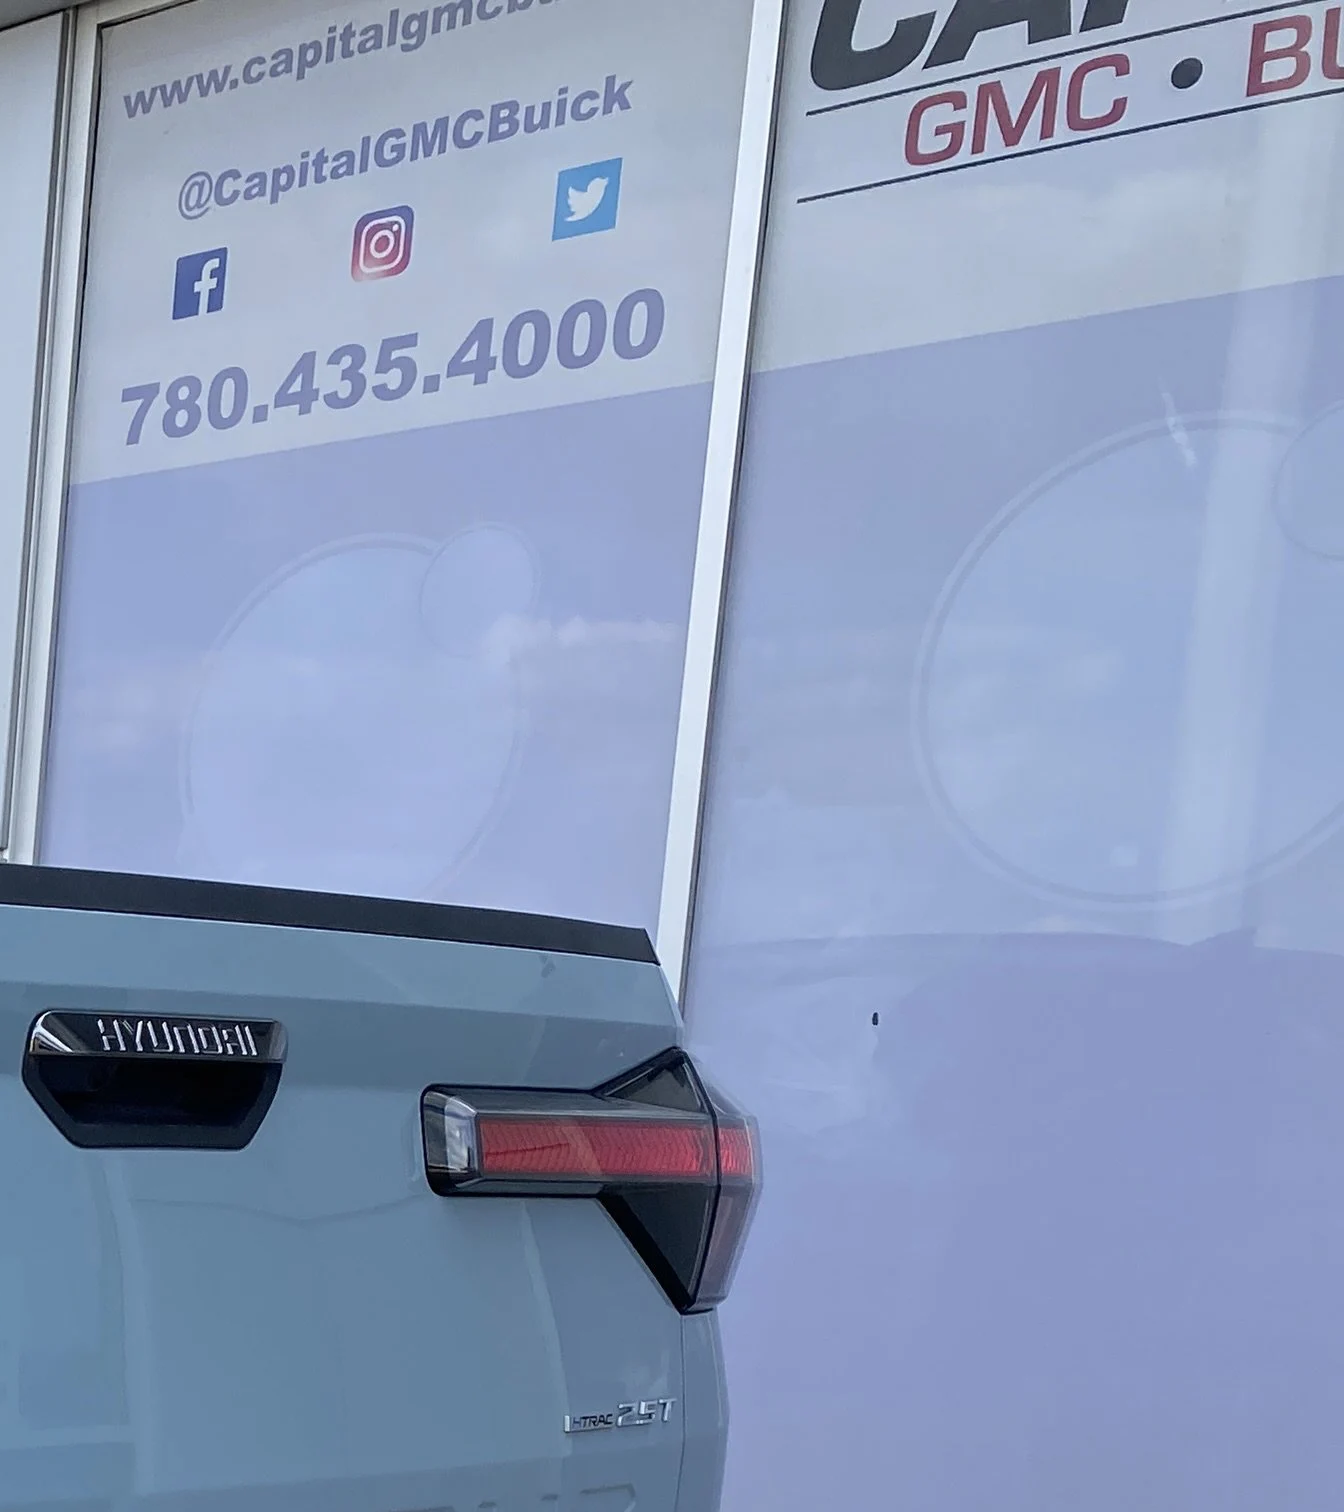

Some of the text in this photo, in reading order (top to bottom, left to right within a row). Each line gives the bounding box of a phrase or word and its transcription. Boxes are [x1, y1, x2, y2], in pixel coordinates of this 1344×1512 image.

[122, 0, 559, 119] www.capitalgmc
[904, 53, 1131, 166] GMC
[177, 73, 633, 221] @CapitalGMCBuick
[120, 288, 665, 446] 780.435.4000
[96, 1018, 258, 1056] HYUNDAI
[571, 1413, 614, 1430] HTRAC
